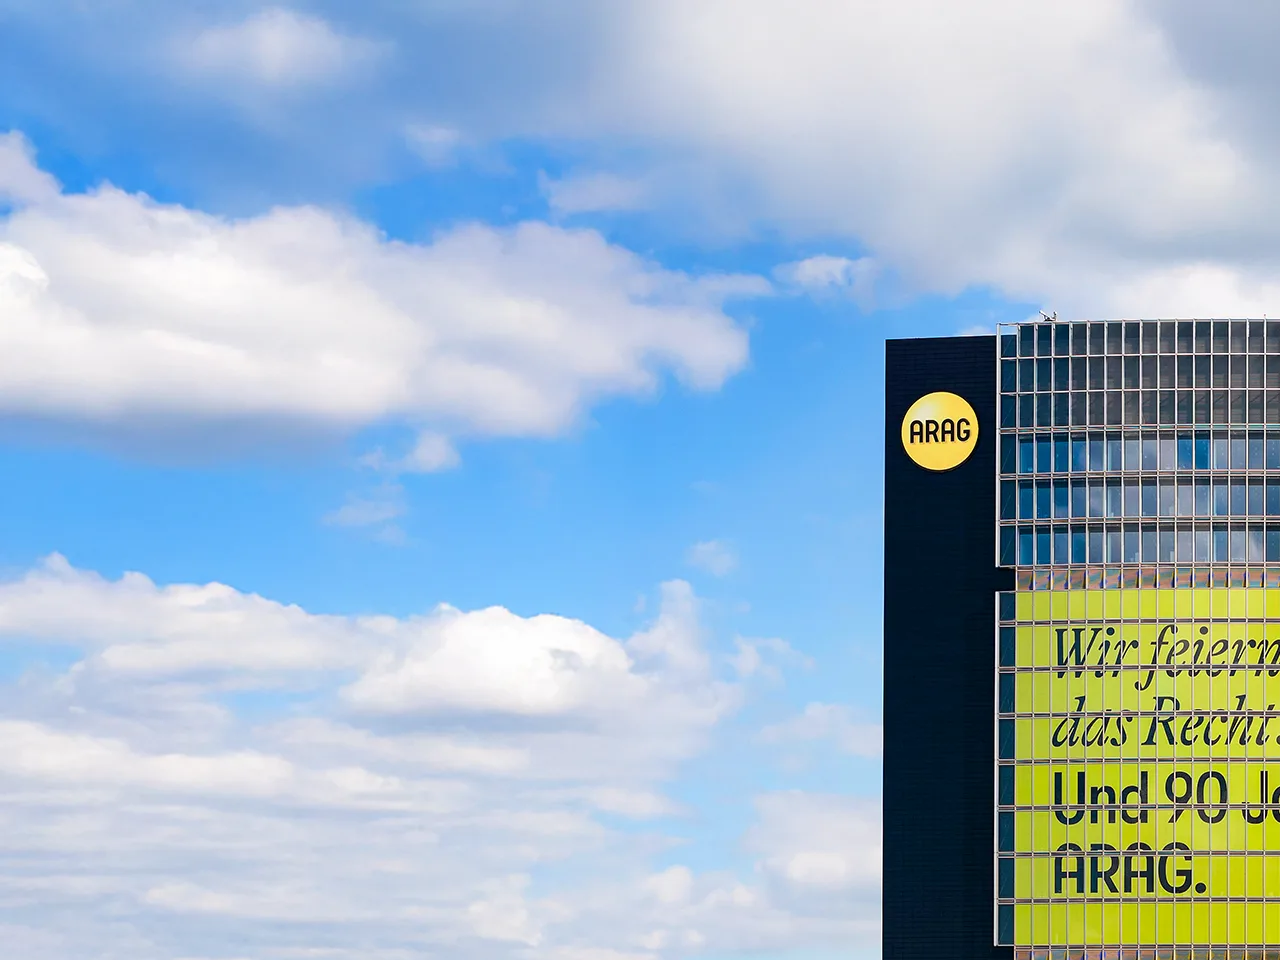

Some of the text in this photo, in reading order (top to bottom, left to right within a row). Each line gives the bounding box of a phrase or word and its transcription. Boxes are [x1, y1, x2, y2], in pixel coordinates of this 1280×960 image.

[910, 418, 970, 443] ARAG
[1055, 627, 1139, 678] Wir
[1052, 695, 1133, 747] das
[1054, 771, 1148, 825] Und
[1165, 771, 1228, 824] 90
[1054, 842, 1207, 894] ARAG.
